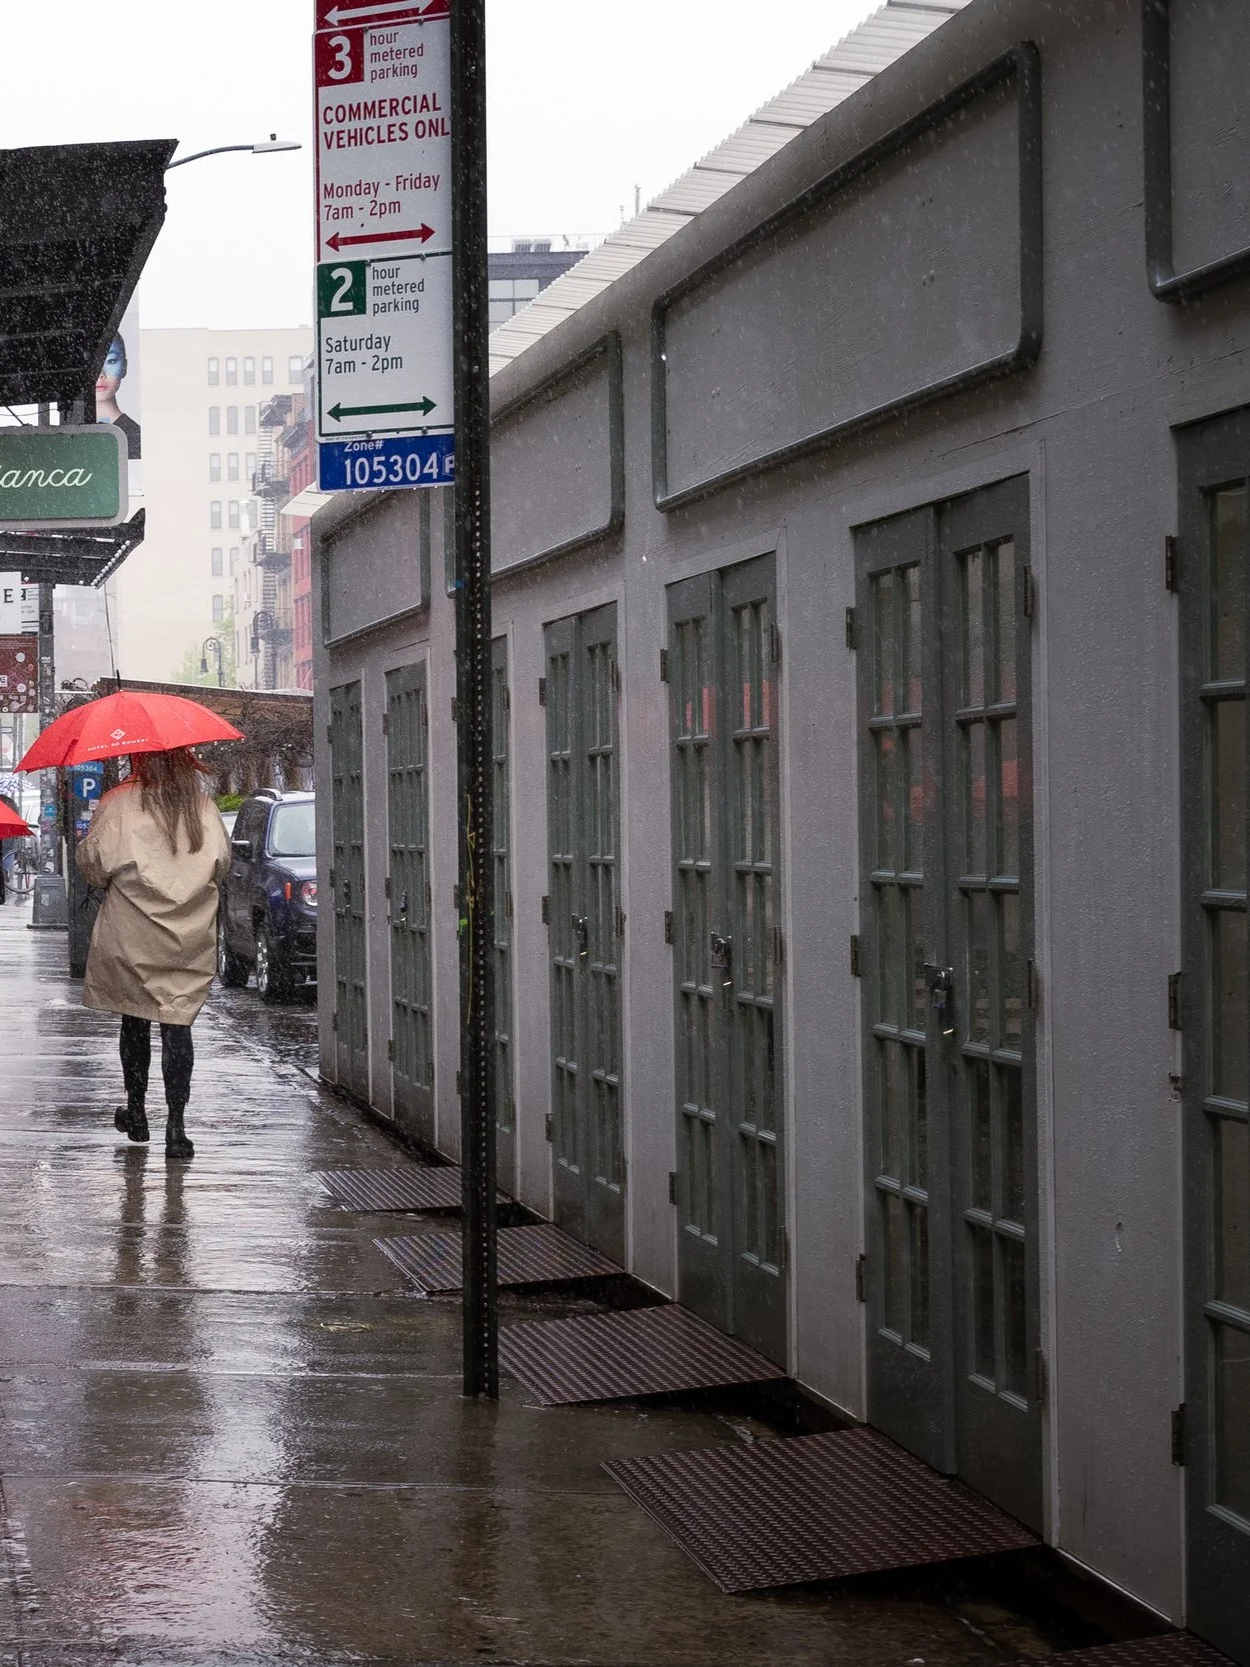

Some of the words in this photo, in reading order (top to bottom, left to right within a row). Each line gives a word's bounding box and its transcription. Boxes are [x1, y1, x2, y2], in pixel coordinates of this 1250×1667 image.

[370, 32, 399, 46] hour
[328, 35, 352, 80] 3
[370, 43, 424, 63] metered
[370, 63, 418, 83] parking
[323, 92, 442, 125] COMMERCIAL
[324, 122, 409, 150] VEHICLES
[414, 117, 452, 139] ONL
[324, 180, 380, 200] Monday
[396, 173, 440, 191] Friday
[324, 204, 353, 221] 7am
[369, 200, 401, 218] 2pm
[372, 267, 400, 280] hour
[330, 267, 354, 312] 2
[372, 279, 425, 296] metered
[372, 298, 419, 316] parking
[326, 334, 391, 354] Saturday
[326, 359, 356, 374] 7am
[372, 355, 403, 374] 2pm
[344, 440, 384, 452] Zone#
[344, 452, 438, 485] 105304
[87, 743, 108, 751] HOTEL
[121, 737, 149, 746] BOWERY
[83, 777, 96, 798] P
